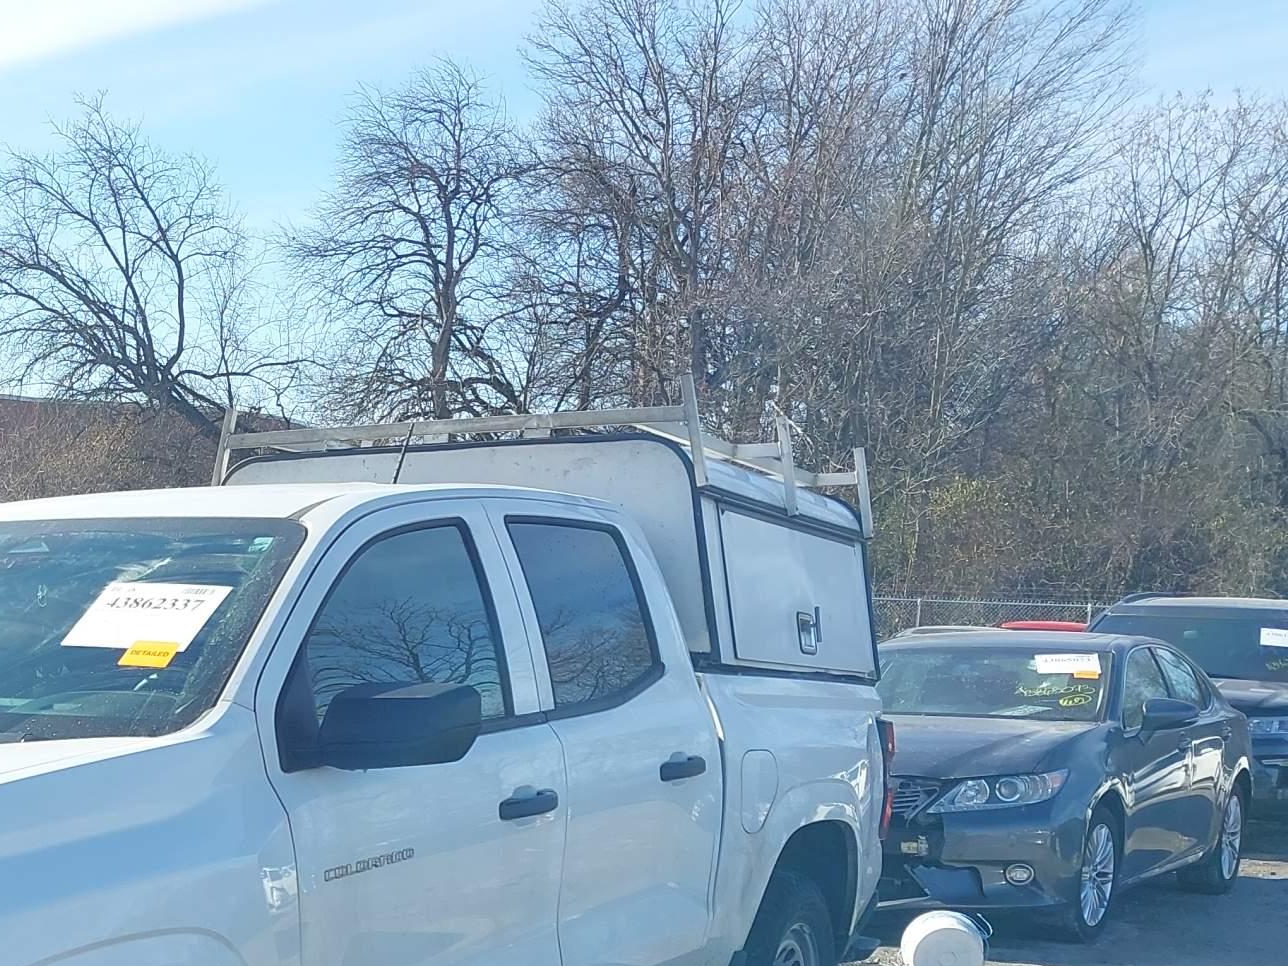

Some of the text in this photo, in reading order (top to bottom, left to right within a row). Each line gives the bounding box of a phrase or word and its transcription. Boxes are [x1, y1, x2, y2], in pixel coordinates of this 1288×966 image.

[106, 596, 205, 611] 43862337
[129, 649, 169, 658] DETAILED
[323, 848, 415, 882] COLORADO
